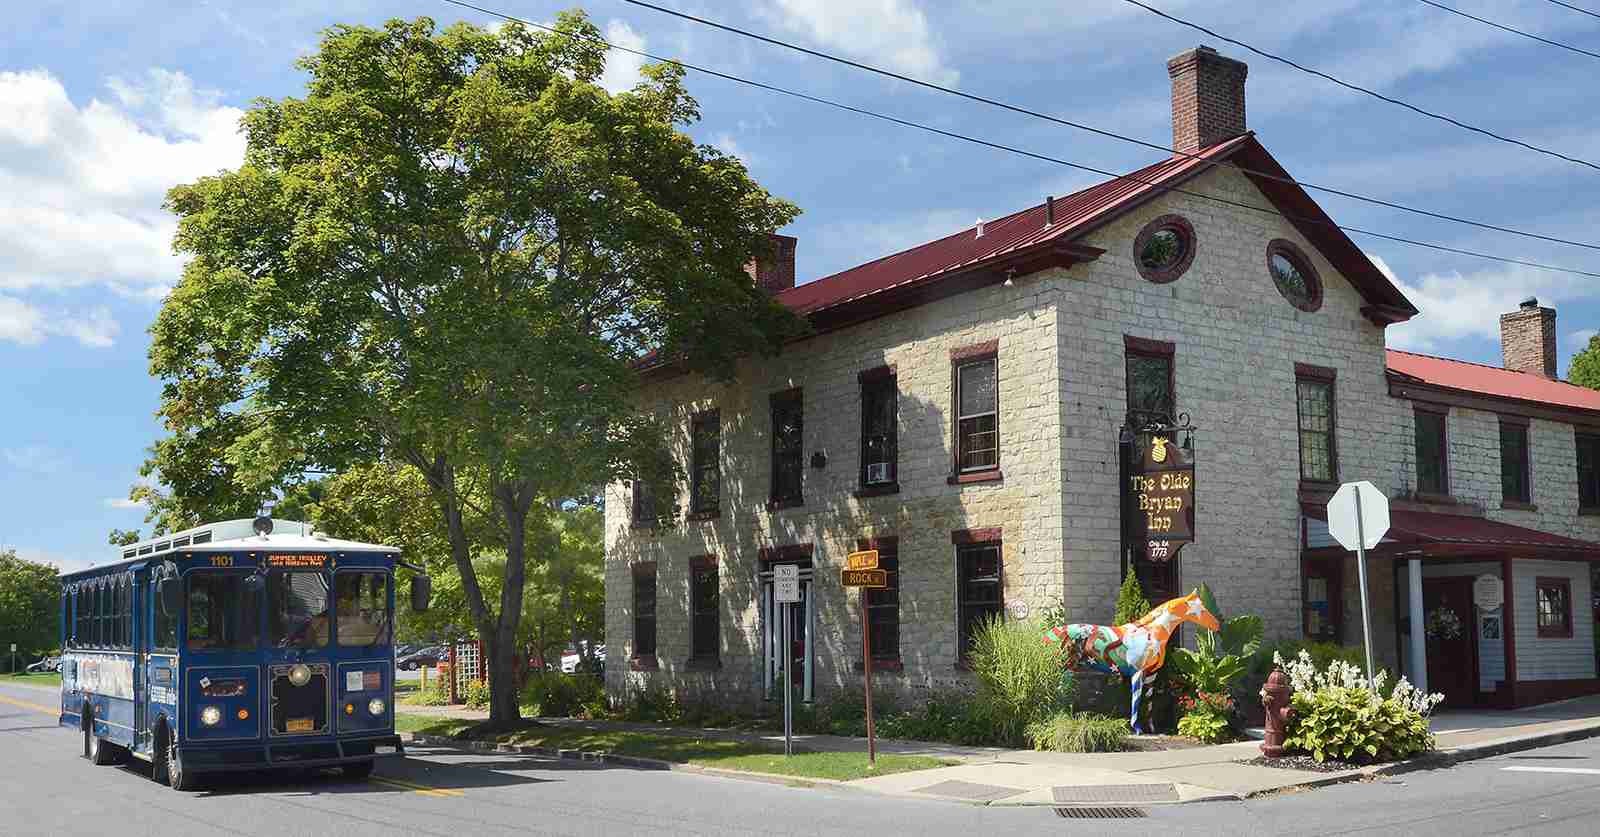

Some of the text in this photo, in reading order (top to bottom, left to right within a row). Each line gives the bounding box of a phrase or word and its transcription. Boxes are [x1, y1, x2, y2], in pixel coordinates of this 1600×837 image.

[1130, 473, 1190, 491] The Olde
[1138, 494, 1183, 513] Bryan
[1147, 512, 1172, 531] Inn
[1152, 547, 1168, 557] 1773
[782, 567, 791, 577] NO
[848, 572, 872, 584] ROCK
